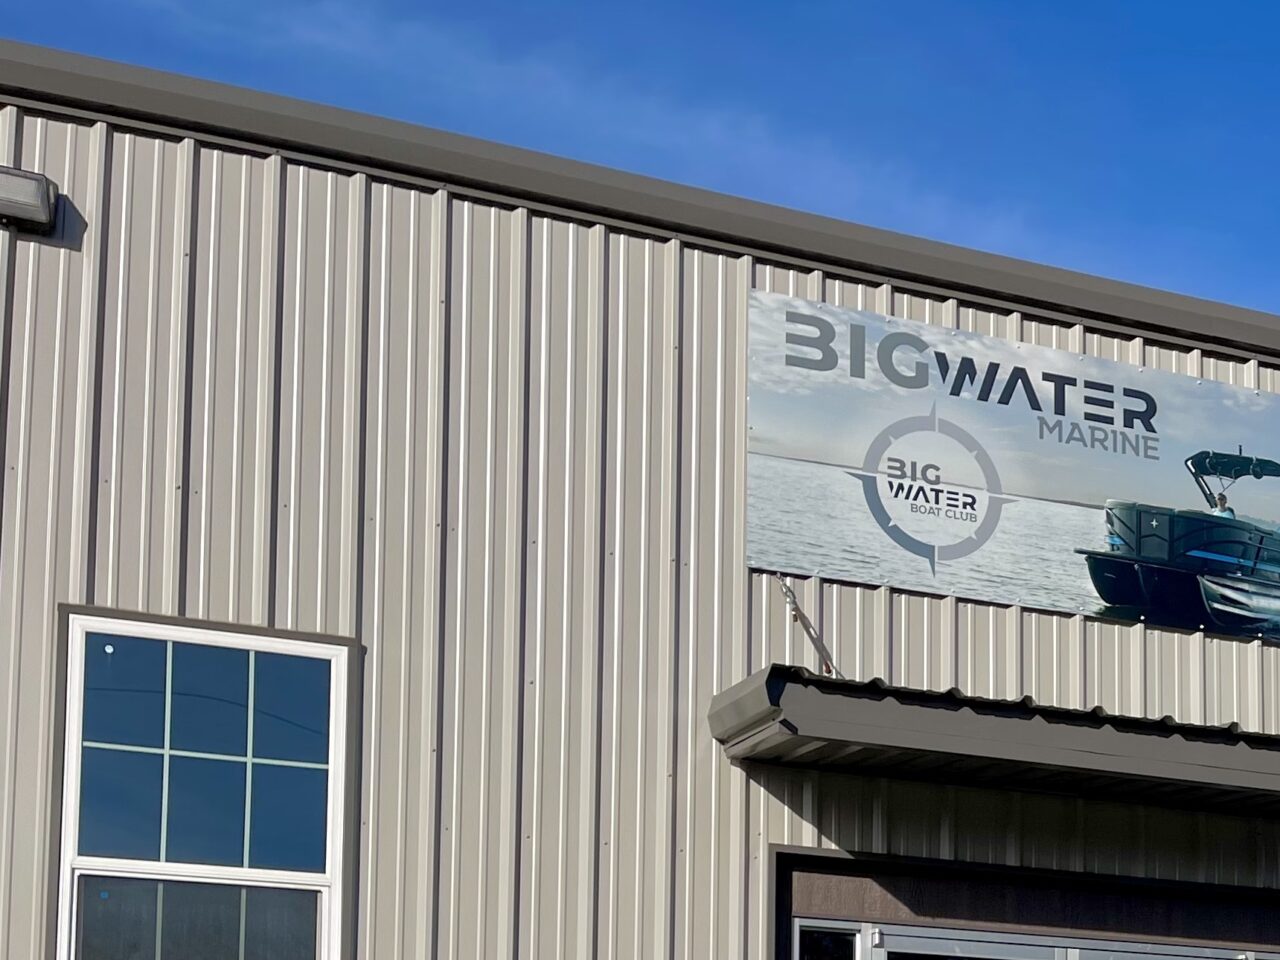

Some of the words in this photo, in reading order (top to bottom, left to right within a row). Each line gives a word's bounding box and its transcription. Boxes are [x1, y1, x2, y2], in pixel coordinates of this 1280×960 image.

[1037, 415, 1160, 461] MARINE
[887, 457, 941, 486] BIG
[887, 480, 977, 511] WATER
[910, 503, 942, 517] BOAT
[945, 509, 978, 523] CLUB
